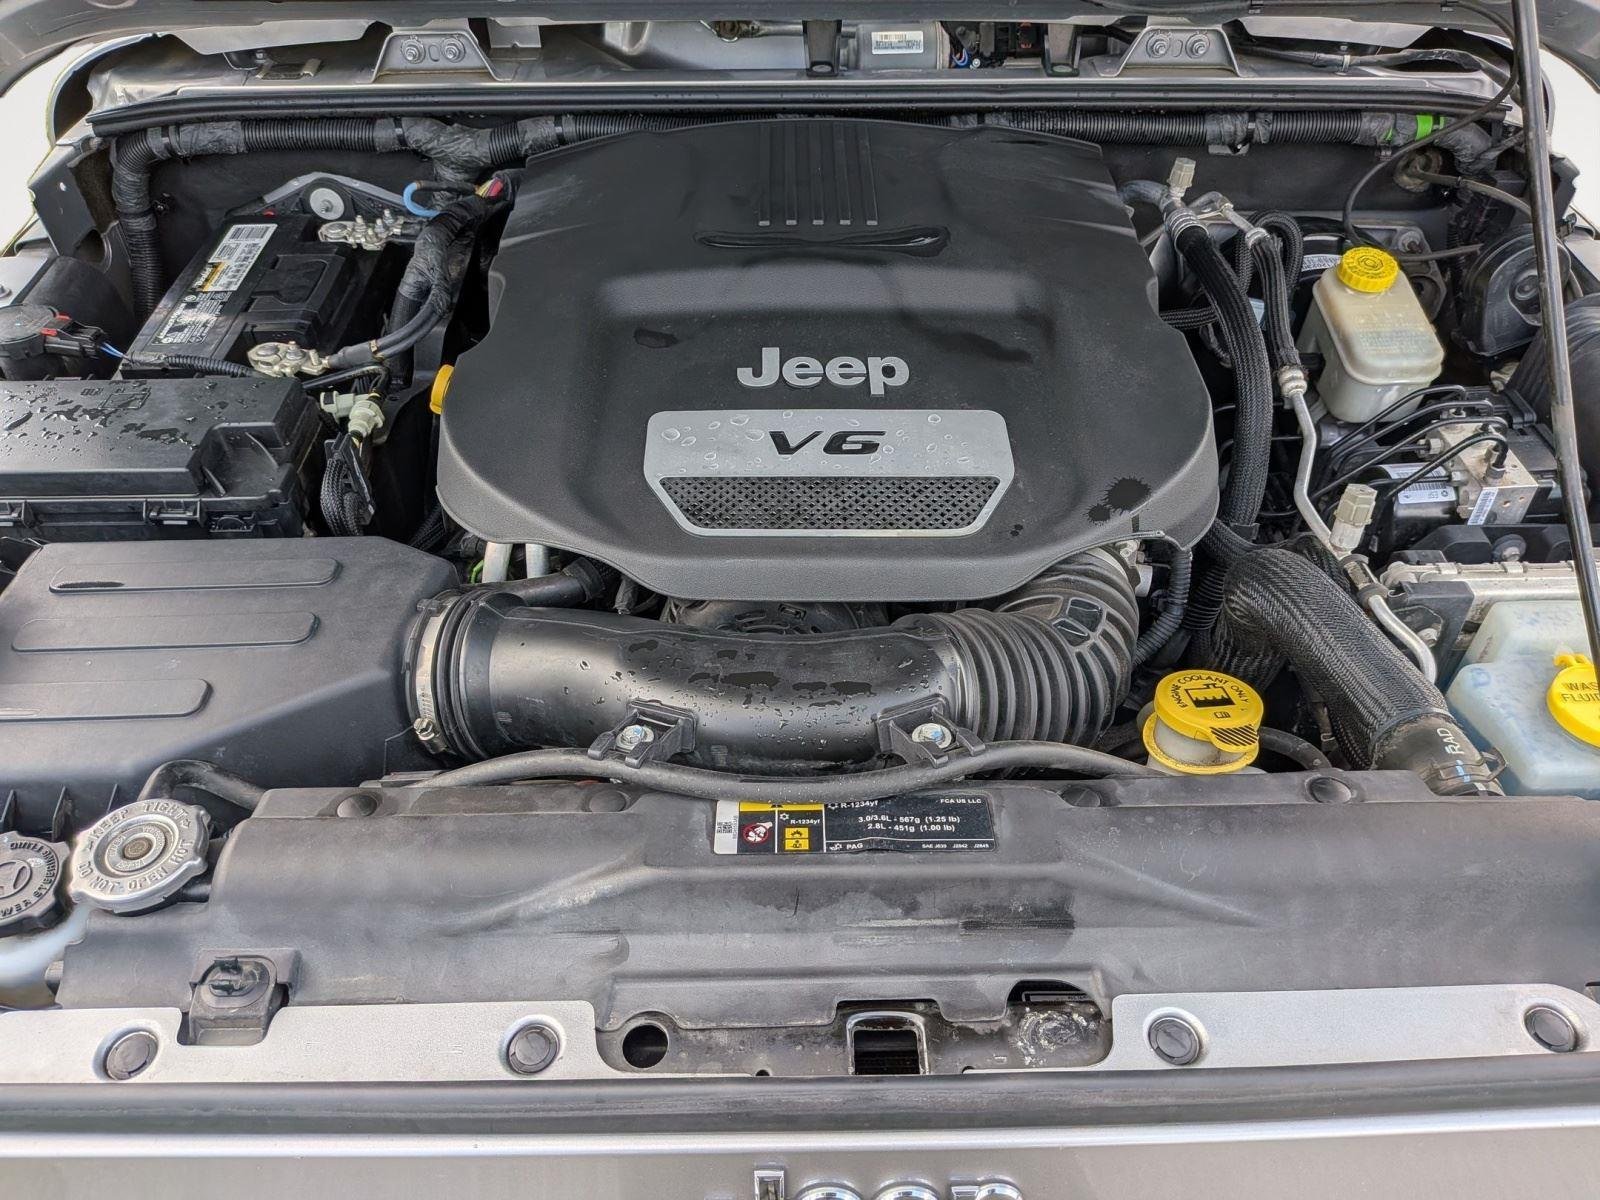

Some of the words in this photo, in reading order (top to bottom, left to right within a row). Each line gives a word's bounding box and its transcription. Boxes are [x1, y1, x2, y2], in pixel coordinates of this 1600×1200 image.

[737, 346, 910, 398] Jeep
[769, 430, 887, 455] V6
[1178, 674, 1229, 685] COOLANT
[1561, 681, 1599, 691] WAS
[1171, 684, 1189, 708] ENGINE
[1231, 684, 1249, 703] ONLY
[1561, 693, 1600, 702] FLUI
[1436, 727, 1465, 755] RAD
[840, 800, 879, 809] R-1234yf
[91, 809, 129, 840] KEEP
[143, 801, 190, 822] TIGHT
[858, 815, 892, 823] 3.0/3.6L
[899, 816, 921, 824] 567g
[925, 816, 946, 824] (1.25
[949, 816, 960, 824] lb)
[919, 824, 941, 832] (1.00
[943, 824, 955, 832] lb)
[90, 874, 121, 893] NOT
[128, 866, 169, 890] OPEN
[170, 839, 193, 865] HOT
[0, 899, 31, 917] WER
